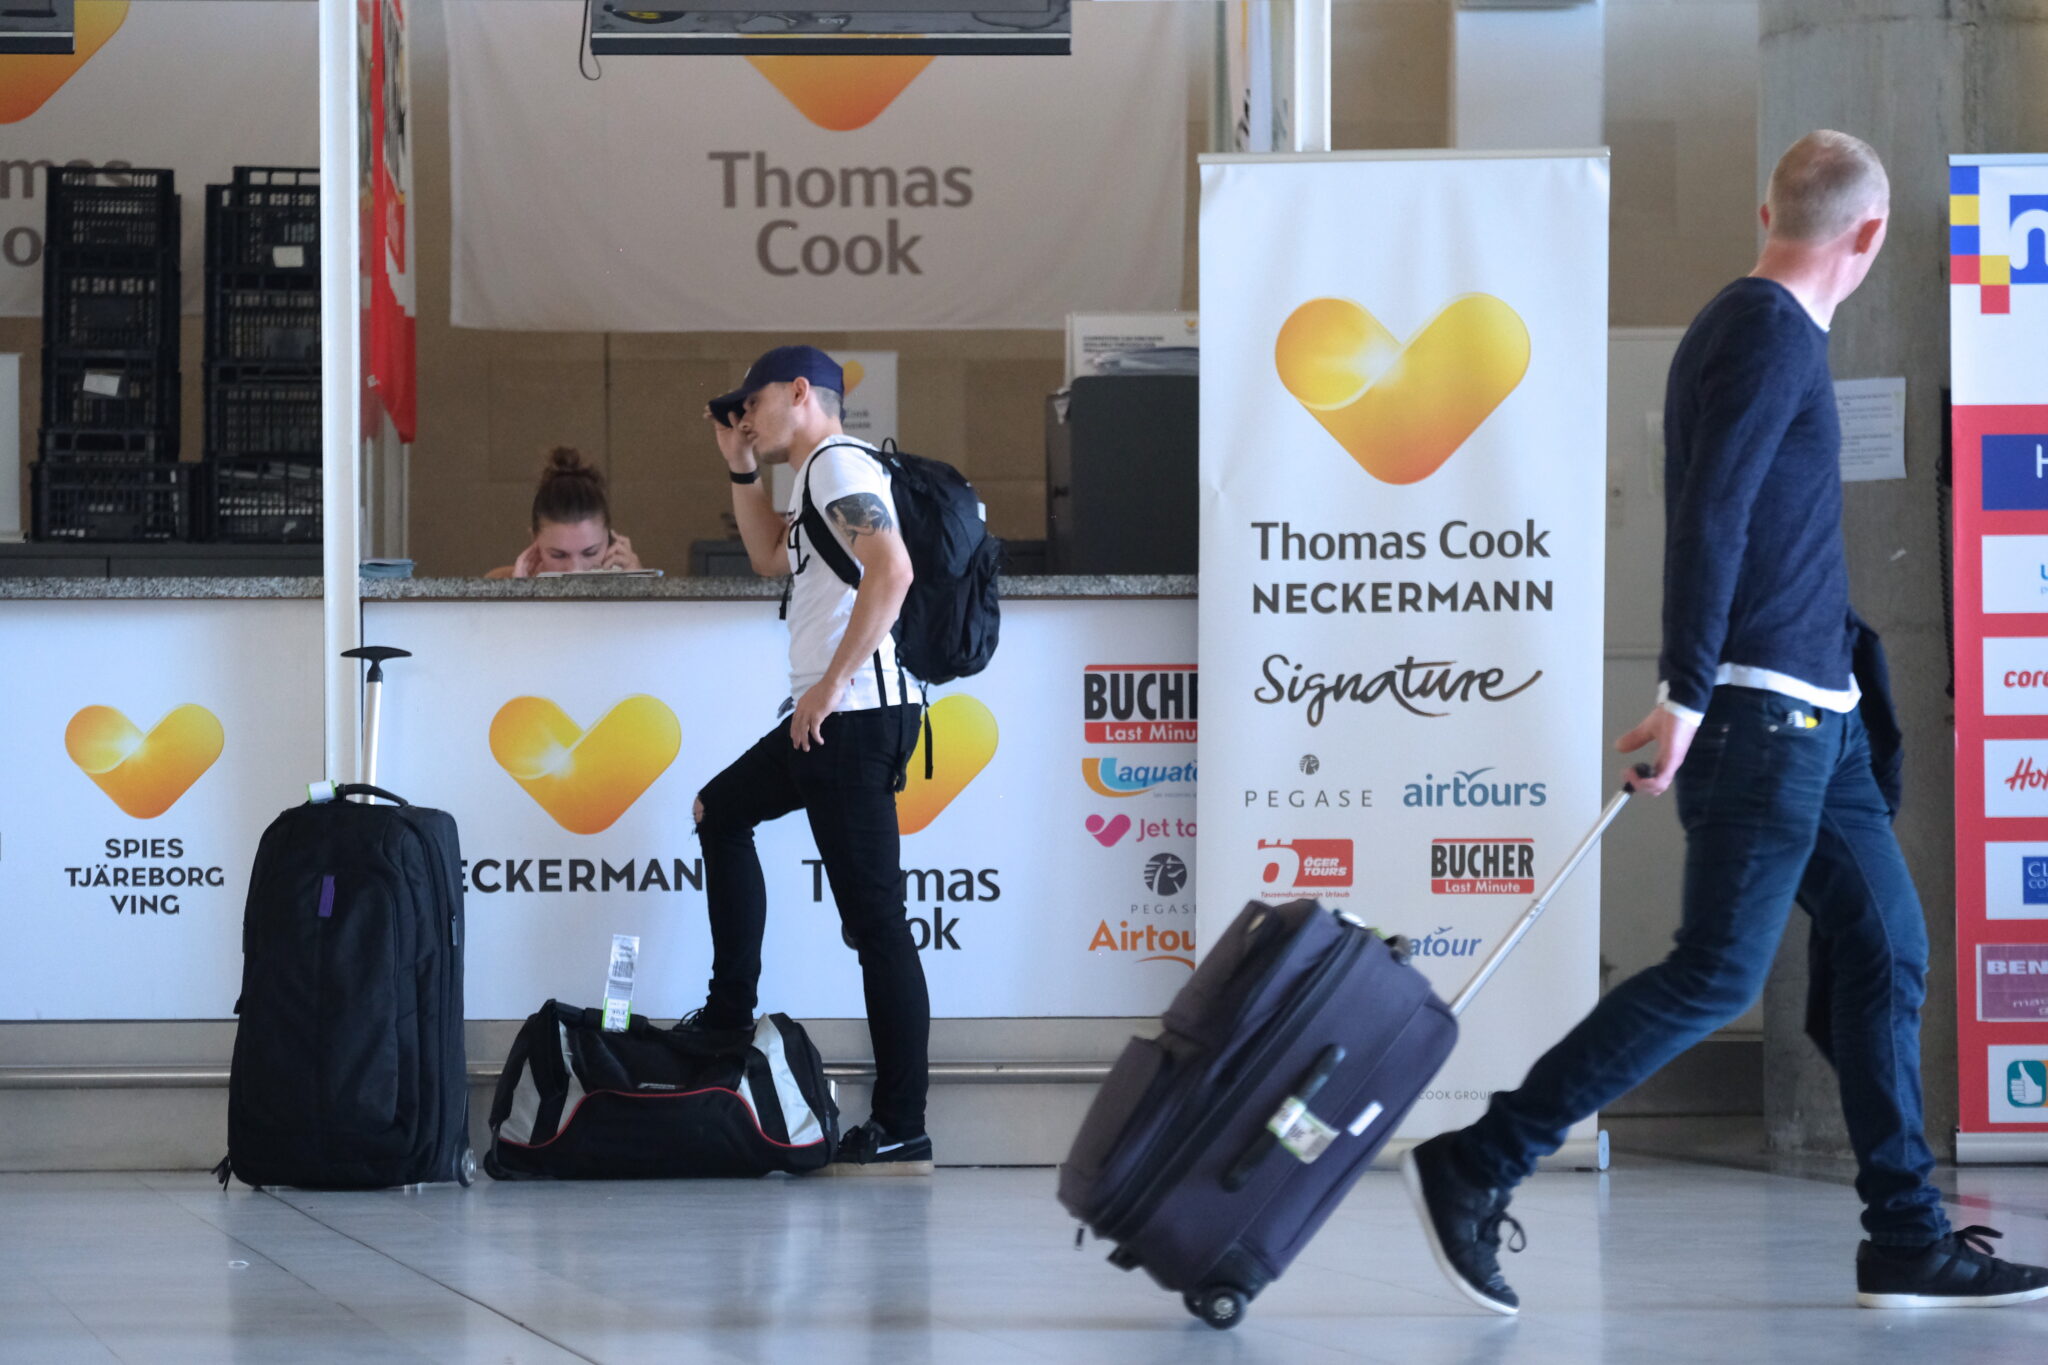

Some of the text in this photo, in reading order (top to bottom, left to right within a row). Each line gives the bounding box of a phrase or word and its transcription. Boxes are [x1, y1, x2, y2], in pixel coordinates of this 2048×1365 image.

[708, 151, 973, 209] Thomas
[755, 219, 924, 277] Cook
[1251, 518, 1551, 562] Thomas Cook
[1251, 579, 1554, 615] NECKERMANN
[1253, 652, 1543, 727] Signature
[1105, 724, 1143, 741] Last
[1244, 789, 1373, 808] PEGASE
[1402, 773, 1547, 808] airtours
[1136, 818, 1171, 843] Jet
[105, 838, 184, 859] SPIES
[1431, 844, 1534, 878] BUCHER
[64, 863, 225, 888] TJÄREBORG
[801, 858, 1001, 903] Tmas
[1304, 867, 1347, 877] TOURS
[1445, 880, 1521, 893] Last Minute
[110, 894, 180, 915] VING
